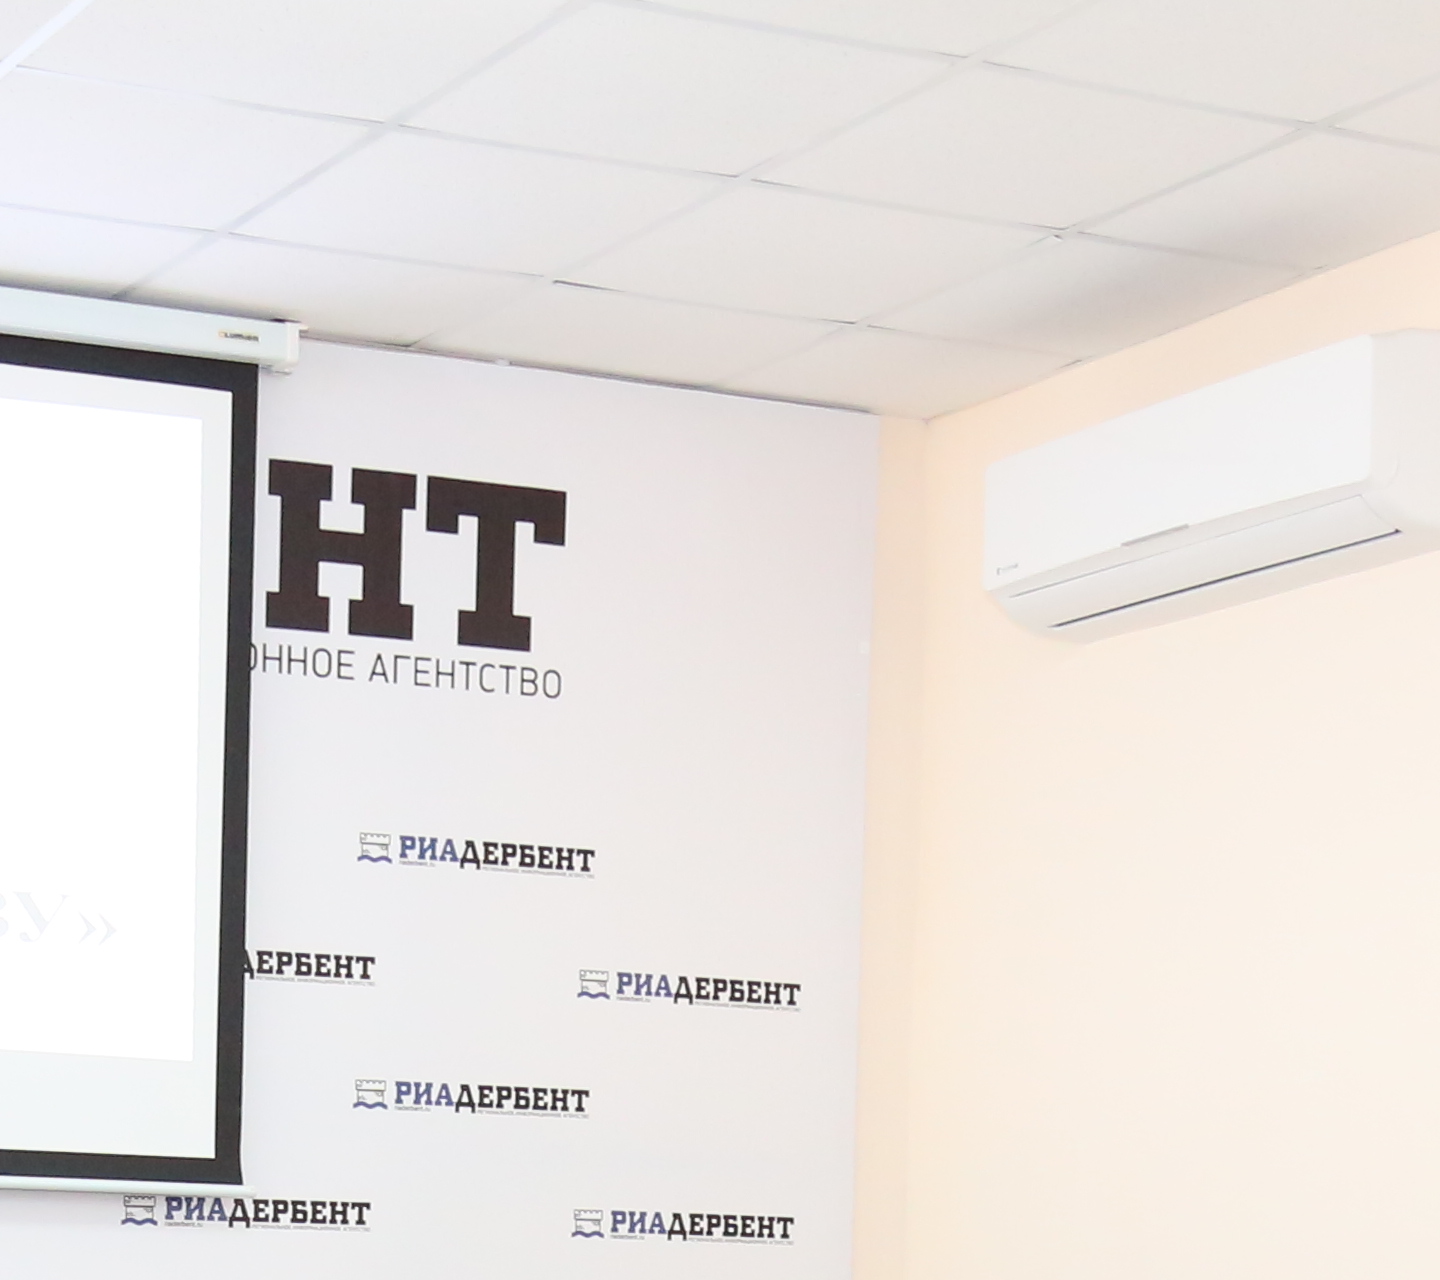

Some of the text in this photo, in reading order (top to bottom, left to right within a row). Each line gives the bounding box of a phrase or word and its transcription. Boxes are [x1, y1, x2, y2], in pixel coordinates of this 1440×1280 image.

[369, 653, 563, 699] АГЕНТСТВО
[399, 835, 596, 873] РИАДЕРБЕНТ
[616, 971, 802, 1007] РИАДЕРБЕНТ
[394, 1080, 590, 1114] РИАДЕРБЕНТ
[165, 1196, 371, 1228] РИАДЕРБЕНТ
[610, 1210, 795, 1242] РИАДЕРБЕНТ
